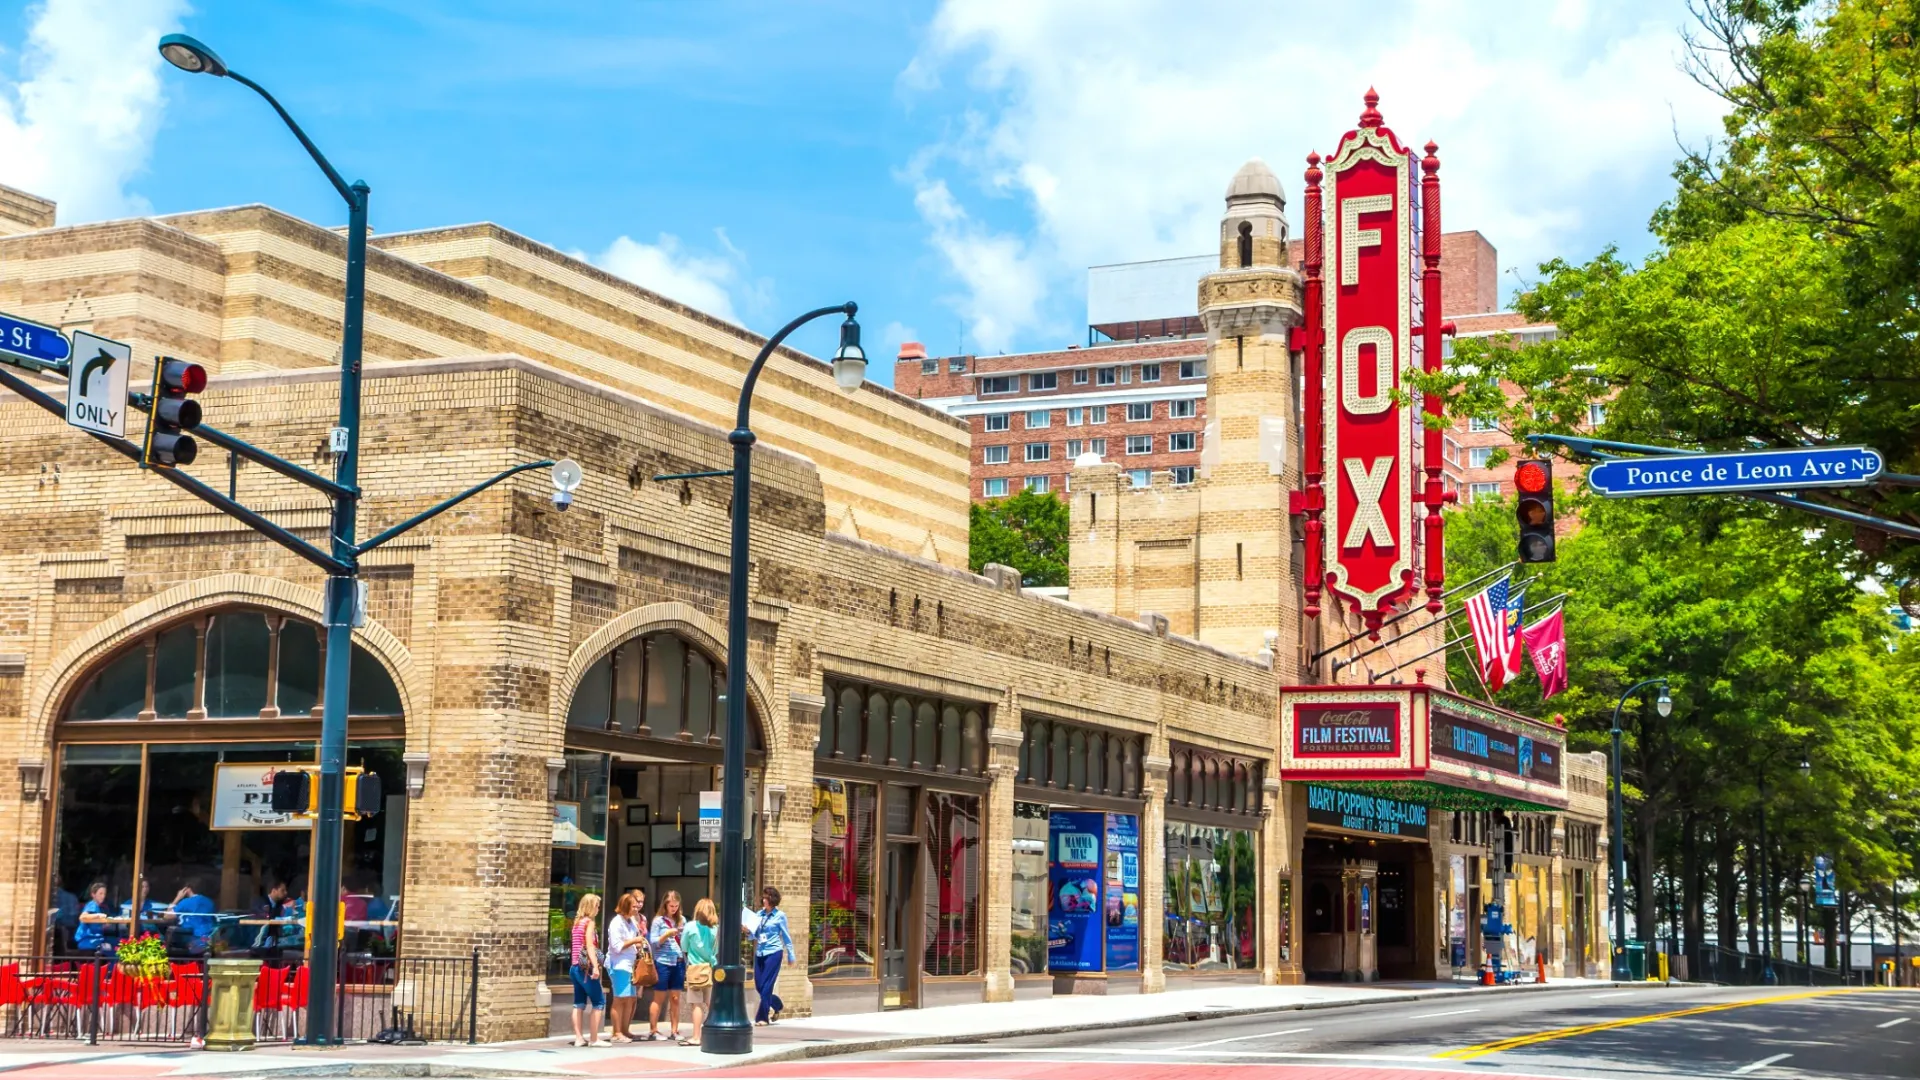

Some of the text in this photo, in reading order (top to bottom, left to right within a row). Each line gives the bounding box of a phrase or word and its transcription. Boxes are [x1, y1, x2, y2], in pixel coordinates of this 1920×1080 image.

[11, 326, 33, 350] St
[1341, 194, 1395, 549] FOX
[76, 402, 118, 427] ONLY
[1627, 457, 1875, 485] Ponce de Leon Ave NE
[1319, 710, 1372, 726] Coca-Cola
[1302, 726, 1391, 744] FILM FESTIVAL
[1302, 744, 1390, 752] FOXTHEATRE.ORG
[1309, 786, 1427, 826] MARY POPPINS SING-A-LONG
[1343, 815, 1365, 830] AUGUST
[1366, 819, 1373, 832] 17
[1064, 836, 1092, 849] MAMMA
[1107, 833, 1138, 847] BROADWAY
[1124, 855, 1137, 866] BLUE
[1124, 865, 1137, 877] MAN
